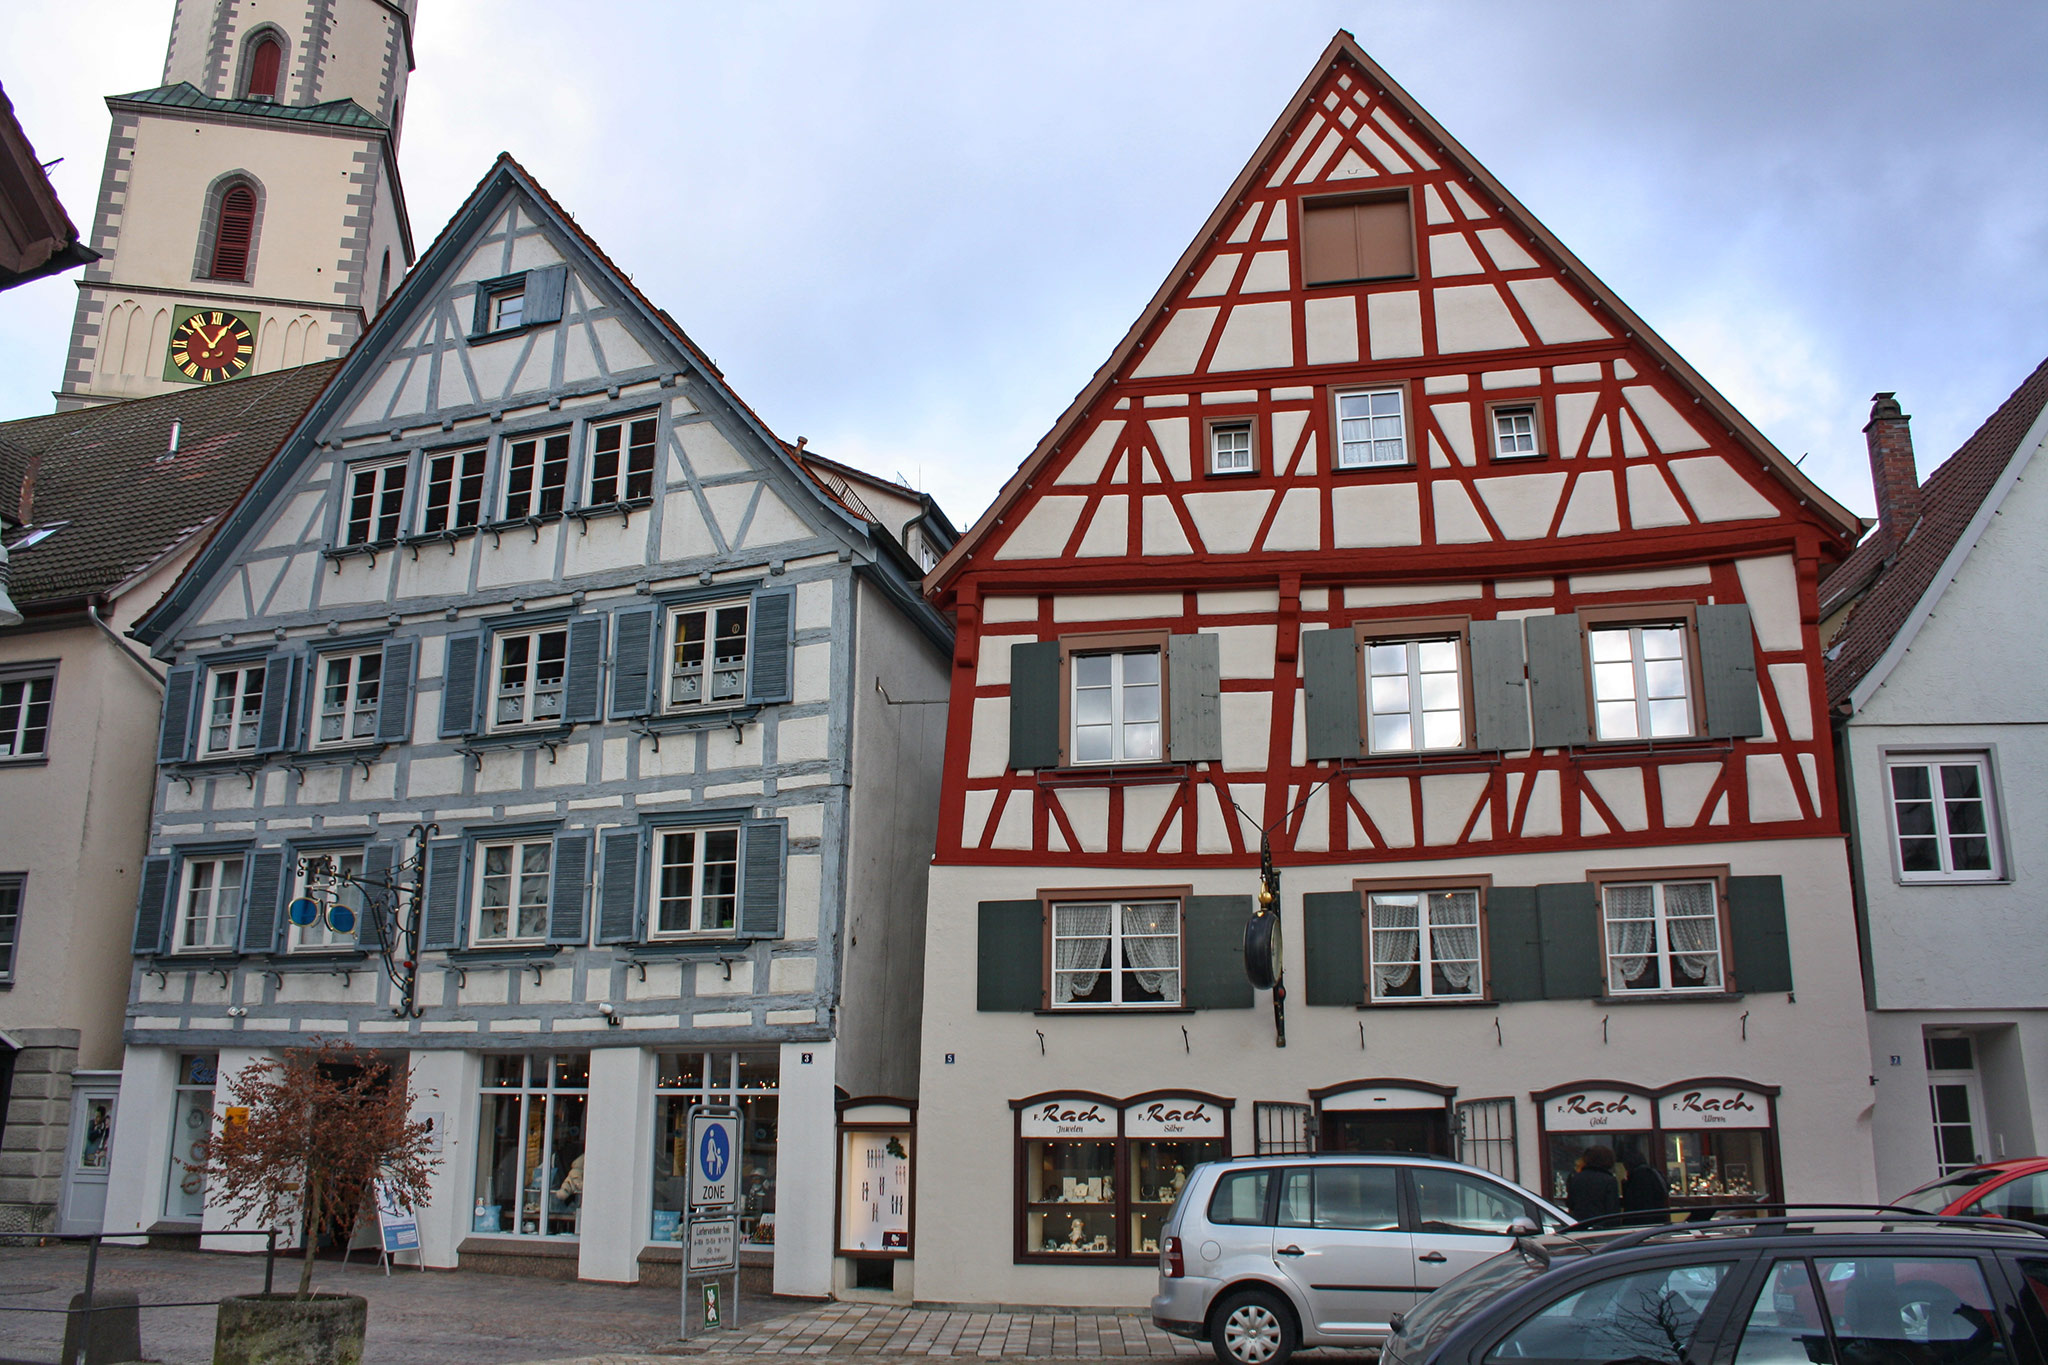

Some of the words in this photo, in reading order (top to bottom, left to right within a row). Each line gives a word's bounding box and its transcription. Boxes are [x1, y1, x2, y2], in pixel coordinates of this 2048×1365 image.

[211, 312, 223, 325] XII
[180, 325, 194, 335] X
[235, 330, 250, 339] II
[172, 340, 187, 348] IX
[238, 345, 252, 354] III
[173, 352, 190, 366] VIII
[232, 357, 246, 370] IV
[184, 362, 199, 377] VII
[203, 369, 212, 381] VI
[221, 367, 230, 379] V
[1557, 1105, 1565, 1113] F.
[1567, 1094, 1637, 1115] Rach
[1672, 1103, 1680, 1111] F.
[1681, 1091, 1755, 1112] Rach
[1033, 1113, 1041, 1121] F.
[1042, 1103, 1106, 1123] Rach
[1138, 1113, 1145, 1121] F.
[1147, 1103, 1212, 1123] Rach
[1589, 1116, 1608, 1127] Gold
[1056, 1125, 1084, 1134] Juwelen
[1163, 1124, 1184, 1133] Silber
[702, 1185, 725, 1200] ZONE
